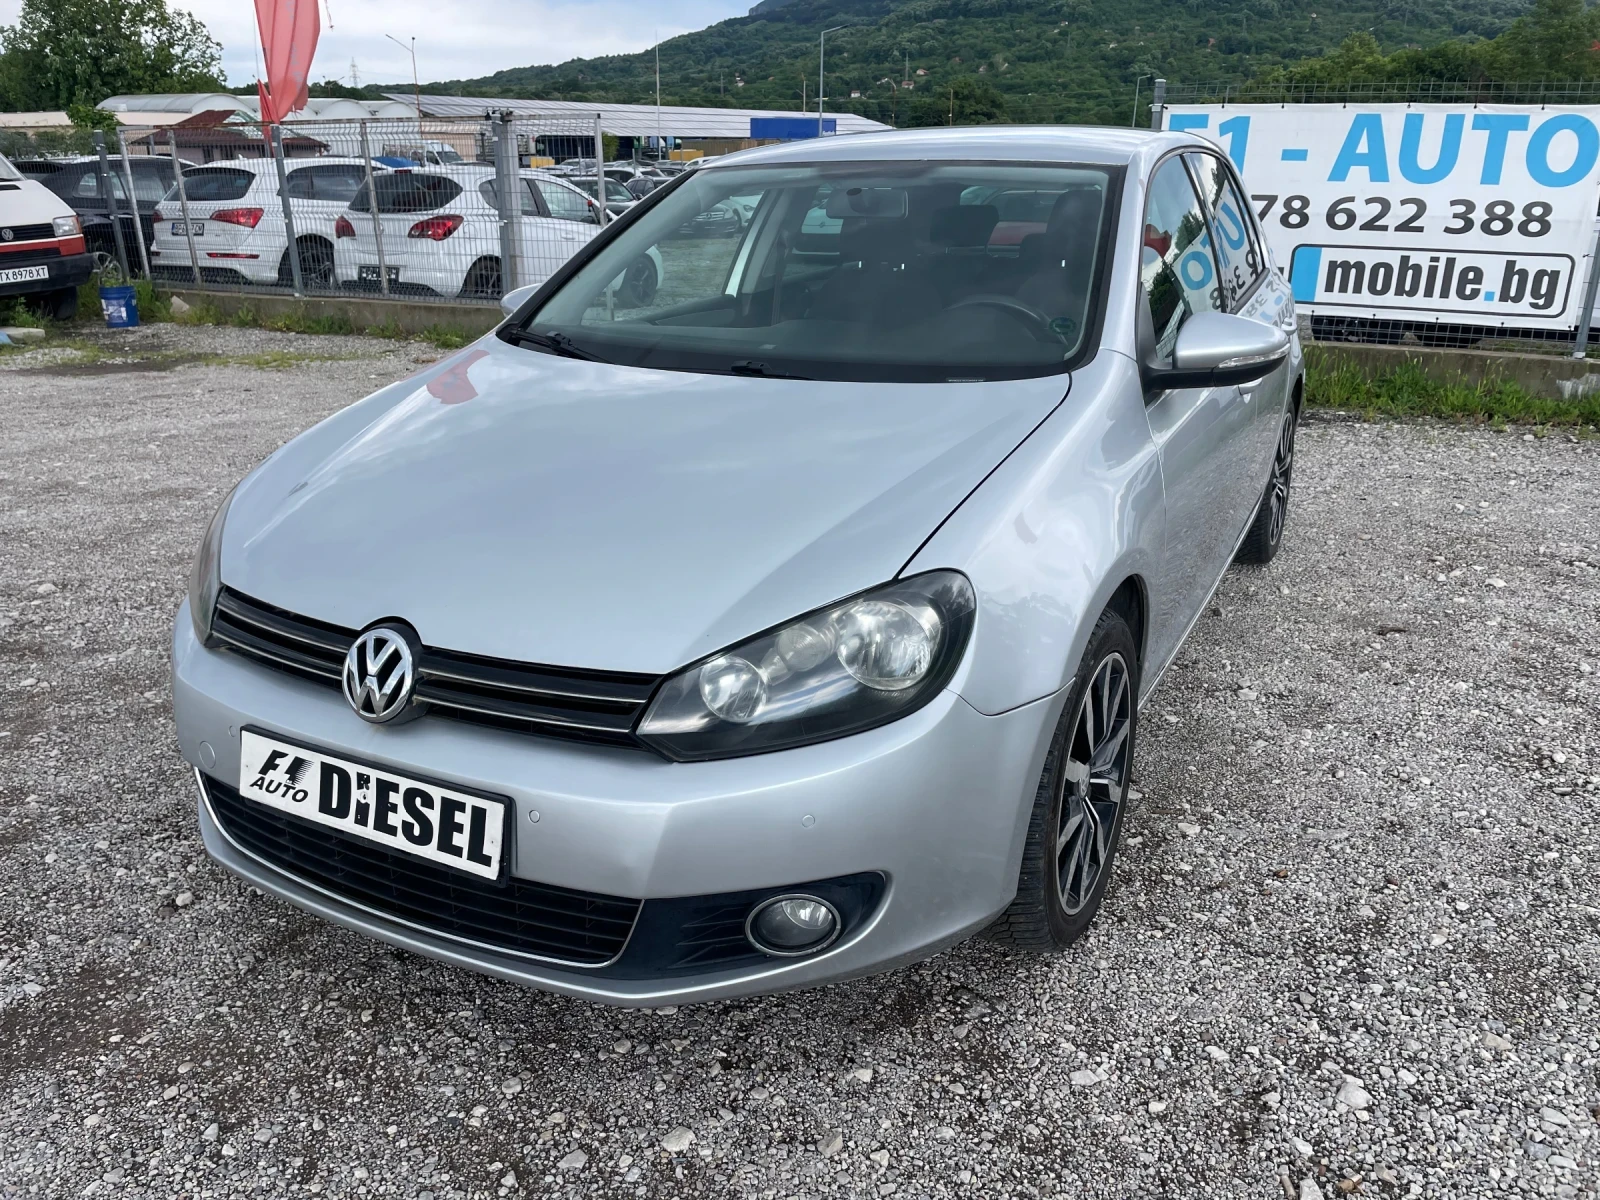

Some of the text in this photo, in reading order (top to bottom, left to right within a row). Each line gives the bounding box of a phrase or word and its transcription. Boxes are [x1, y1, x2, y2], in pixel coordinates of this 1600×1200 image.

[1169, 114, 1251, 176] 1
[1327, 114, 1599, 188] AUTO
[1325, 196, 1427, 233] 622
[1443, 198, 1553, 238] 388
[12, 268, 34, 280] 8978
[35, 267, 46, 277] XT
[1324, 254, 1561, 310] mobile.bg
[250, 776, 308, 802] AUTO
[318, 761, 492, 867] DIESEL
